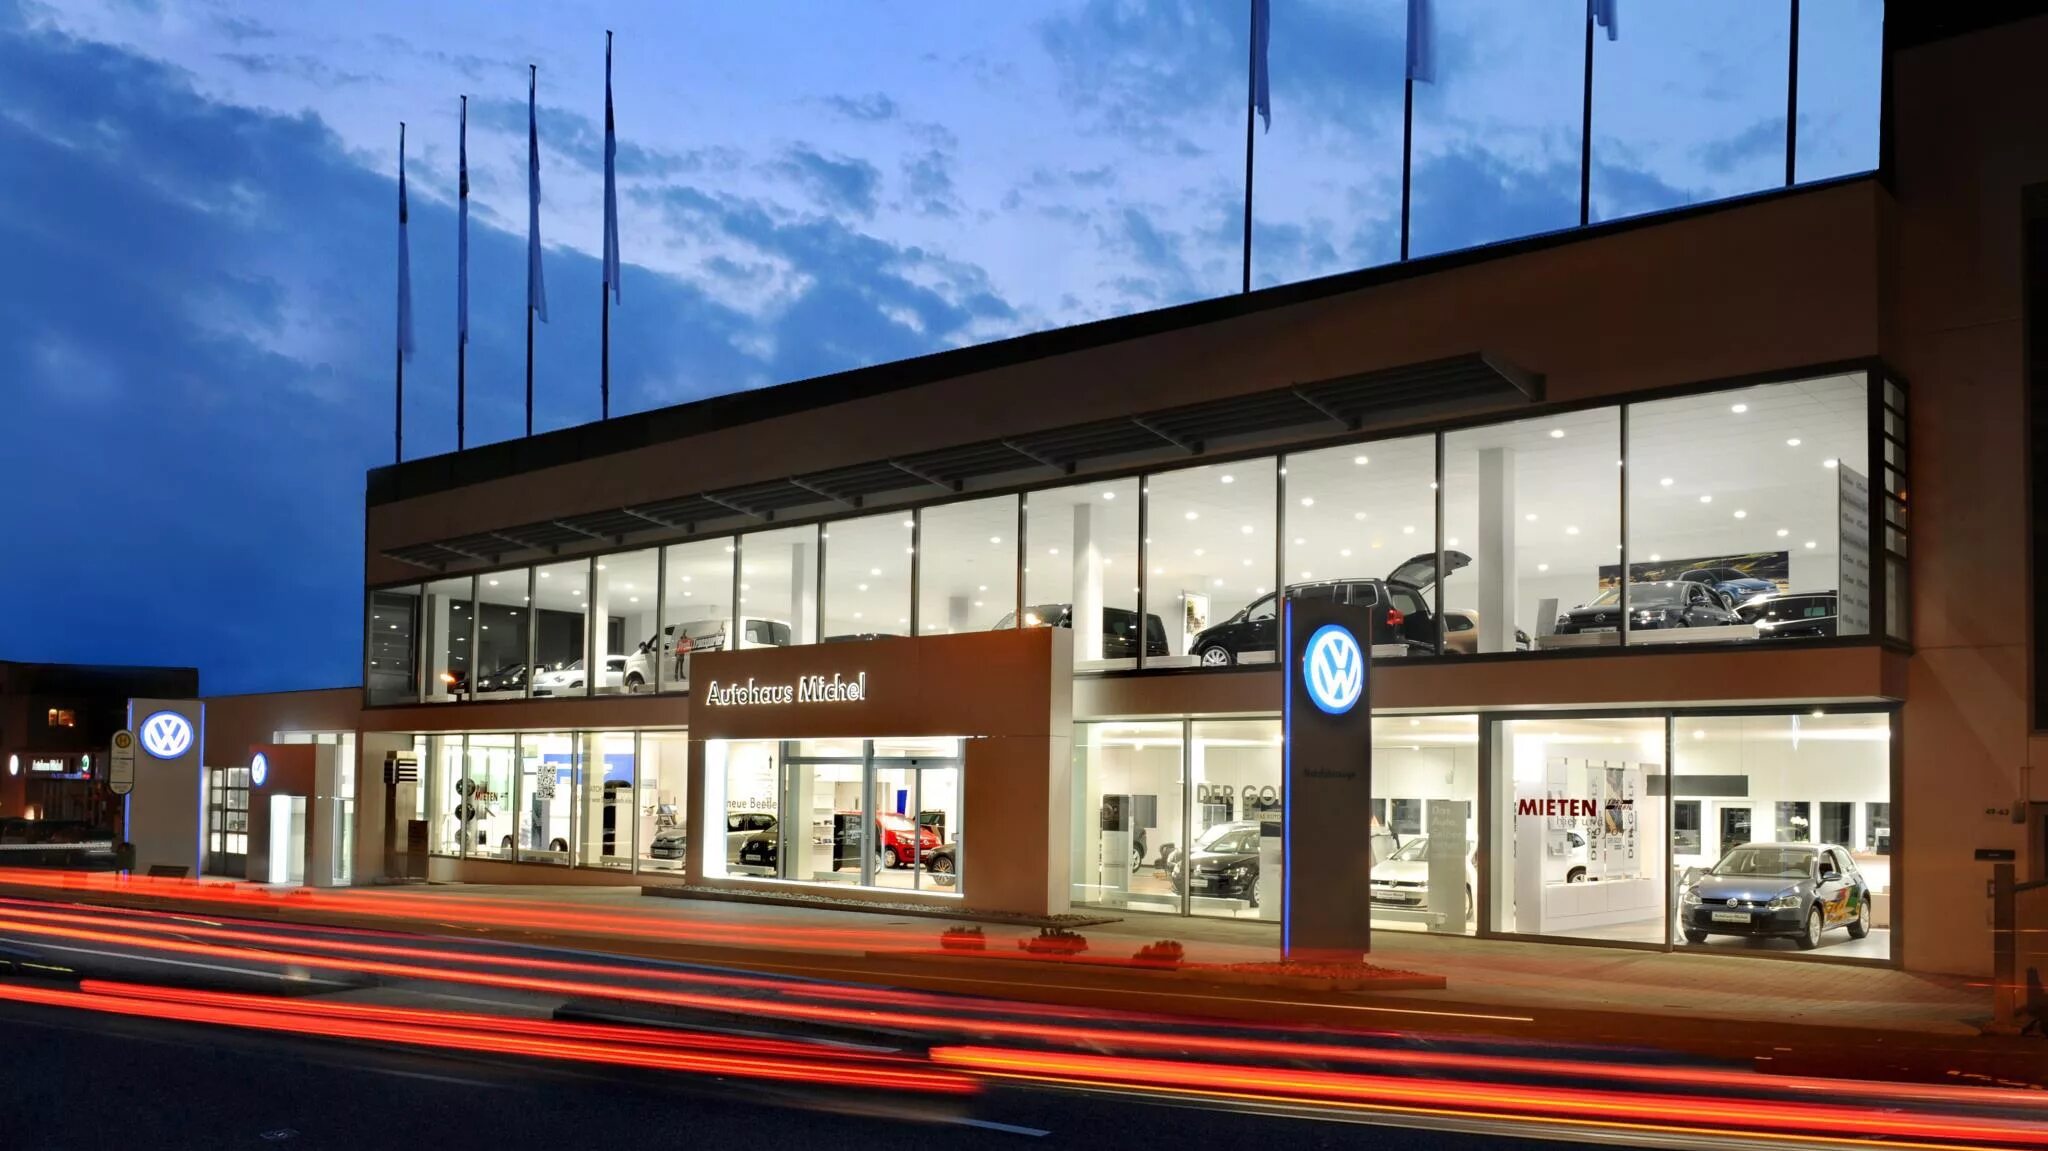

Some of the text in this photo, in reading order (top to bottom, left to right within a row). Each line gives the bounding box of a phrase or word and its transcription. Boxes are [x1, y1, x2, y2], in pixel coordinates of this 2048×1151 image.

[705, 671, 867, 706] Autohaus Michel
[750, 797, 777, 809] Beetle
[1196, 784, 1234, 804] DER
[1518, 798, 1597, 816] MIETEN
